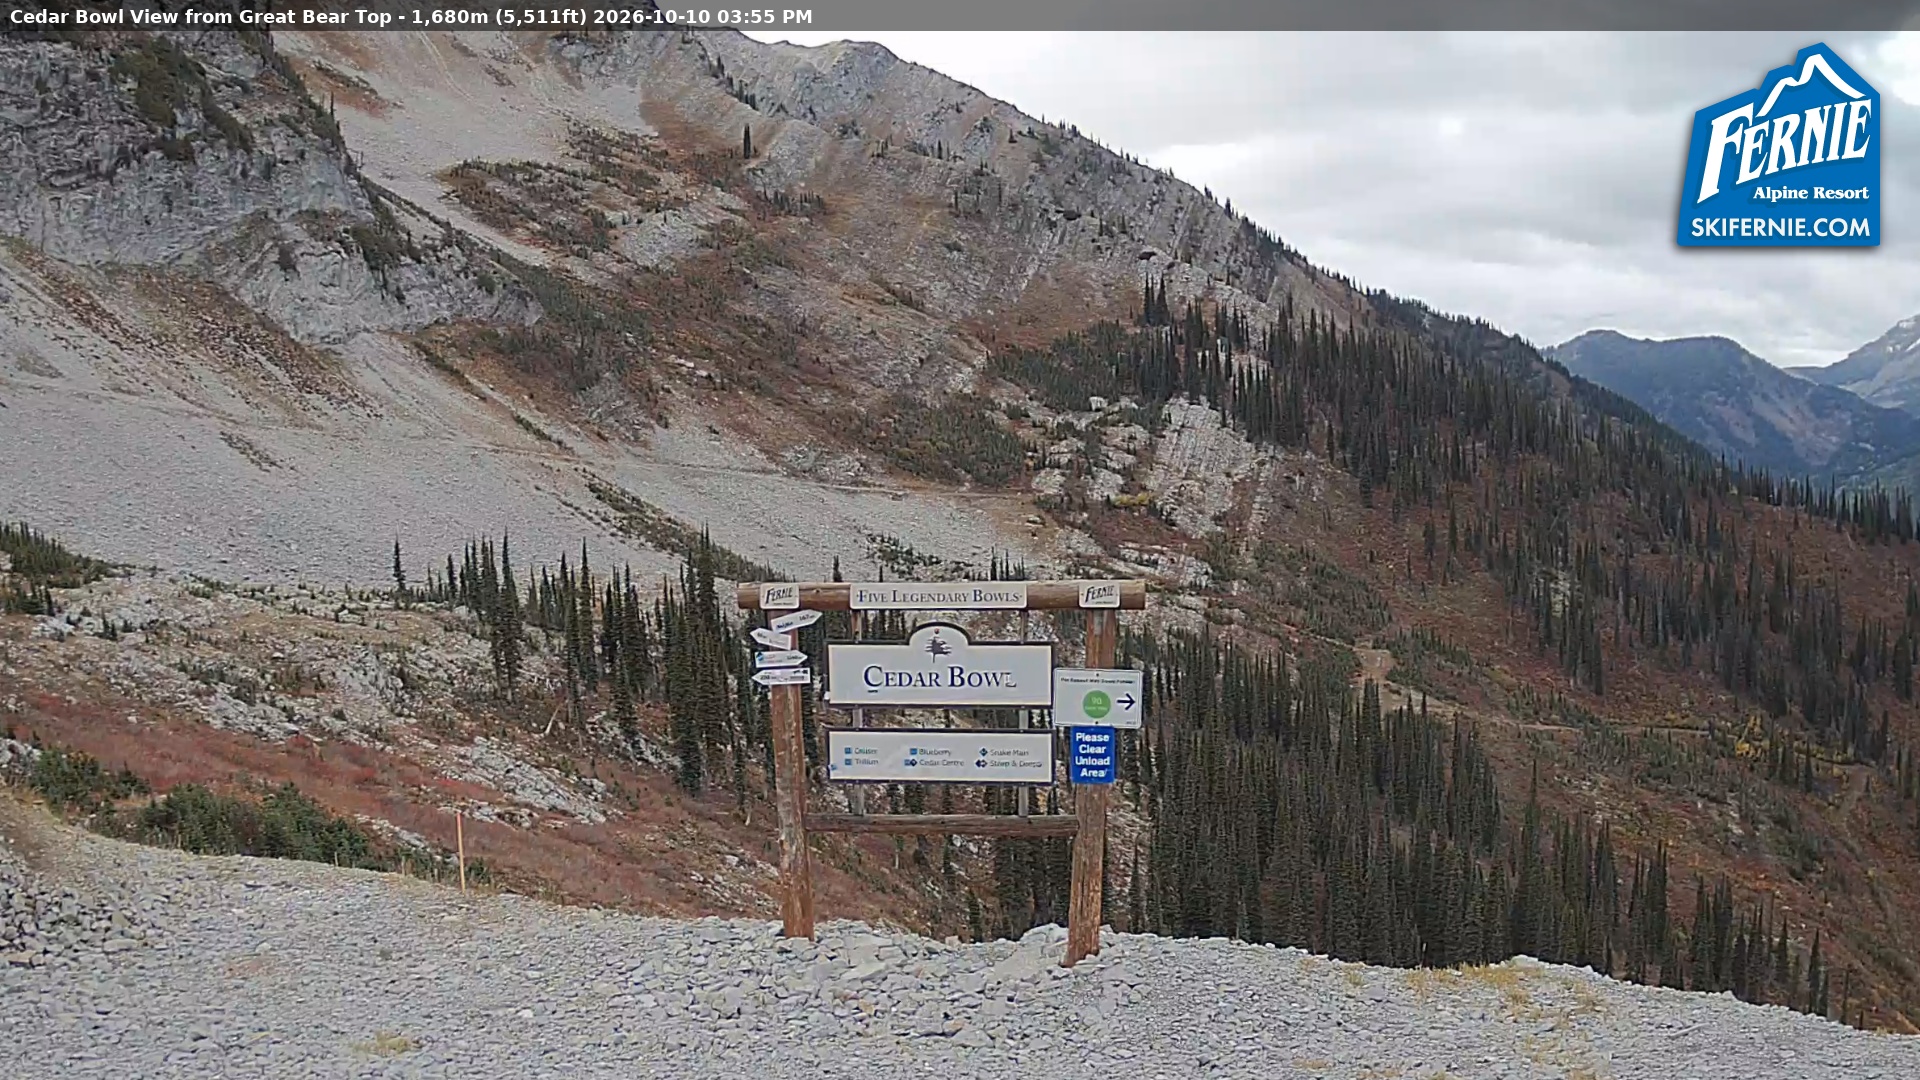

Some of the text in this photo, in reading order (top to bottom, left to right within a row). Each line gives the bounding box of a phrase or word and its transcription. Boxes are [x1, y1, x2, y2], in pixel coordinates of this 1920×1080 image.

[857, 589, 1019, 603] FIVE LEGENDARY BOWLS
[863, 665, 1017, 688] CEDAR BOWL
[1075, 732, 1110, 742] Please
[1078, 744, 1107, 754] Clear
[1075, 756, 1111, 766] Unload
[1080, 768, 1106, 777] Area
